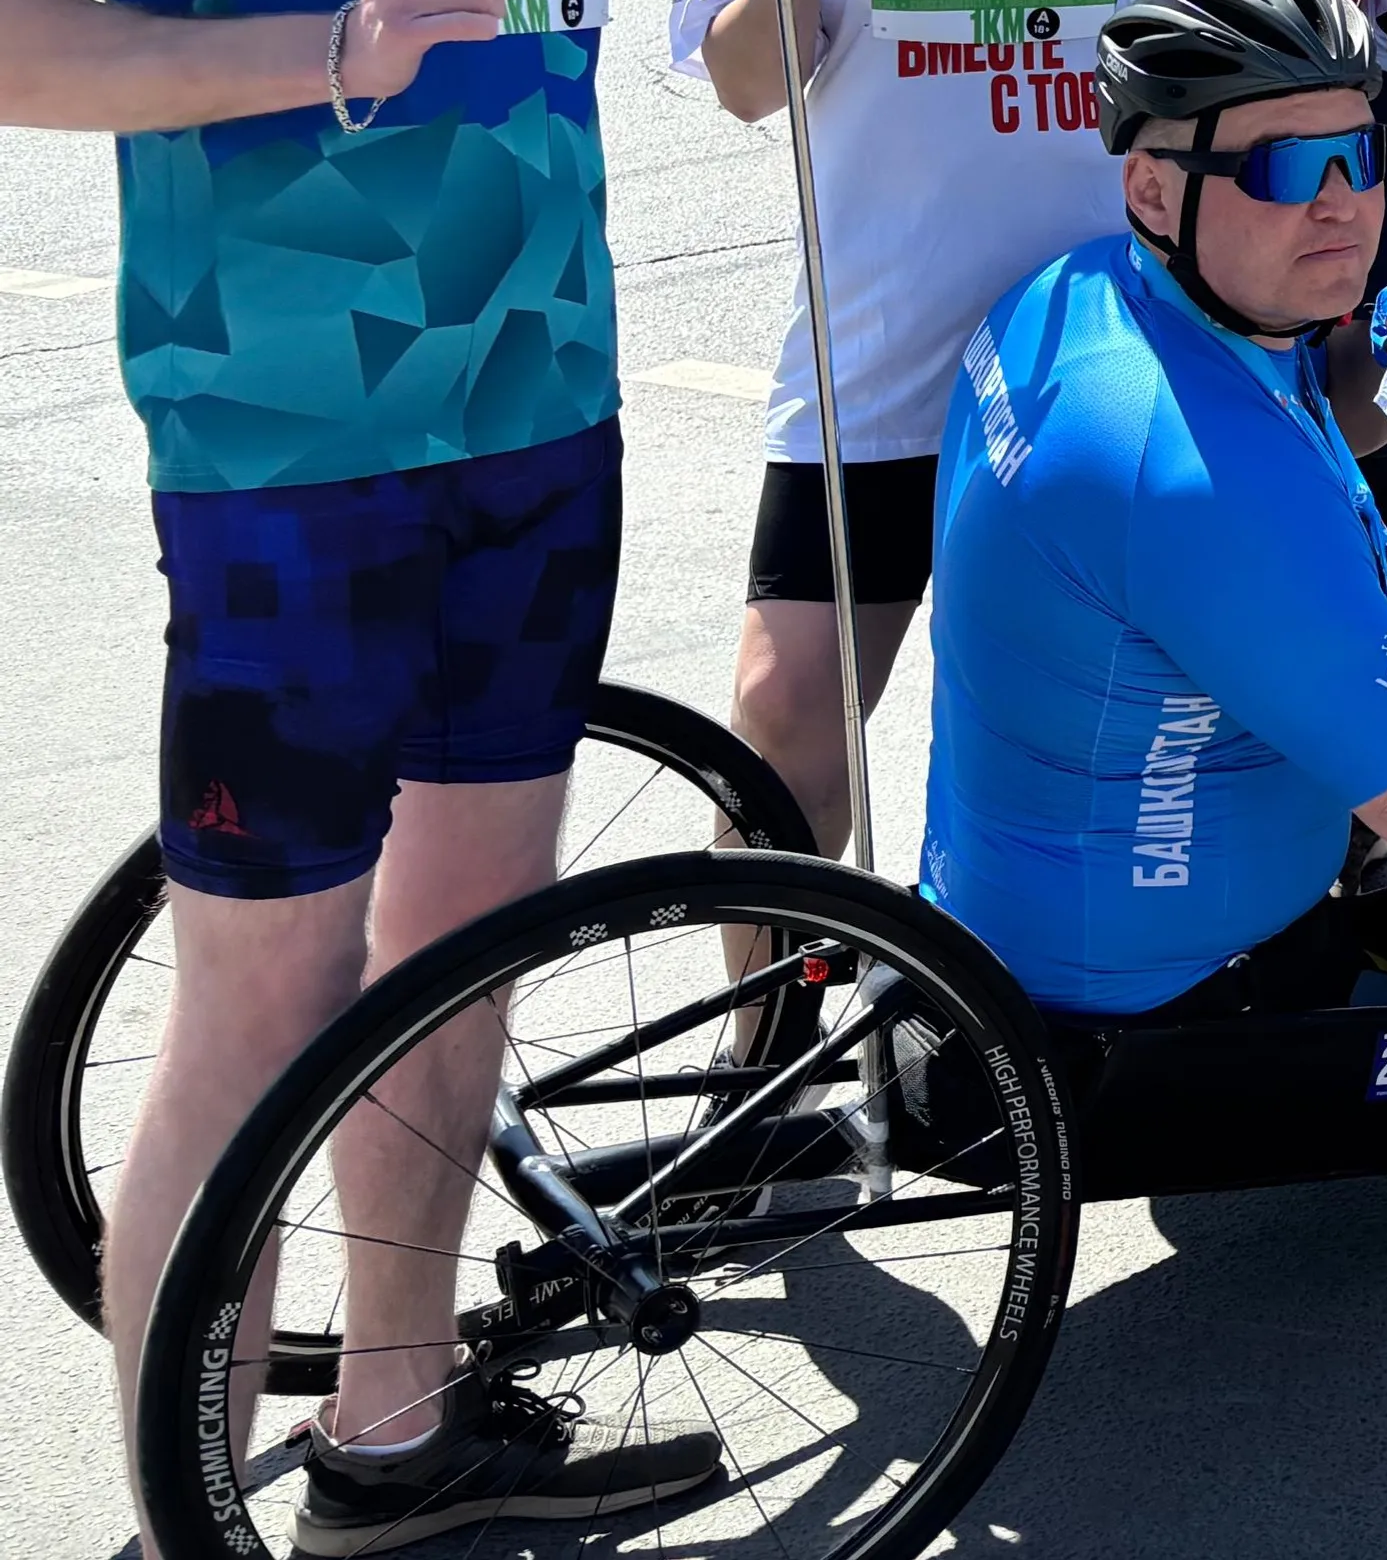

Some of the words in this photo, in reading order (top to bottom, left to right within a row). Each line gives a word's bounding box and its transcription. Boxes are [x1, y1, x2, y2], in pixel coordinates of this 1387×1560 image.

[984, 1044, 1023, 1095] HIGH
[1005, 1094, 1042, 1249] PERFORMANCE
[1062, 1172, 1072, 1201] PRO
[1000, 1252, 1038, 1342] WHEELS
[197, 1345, 241, 1524] SCHMICKING
